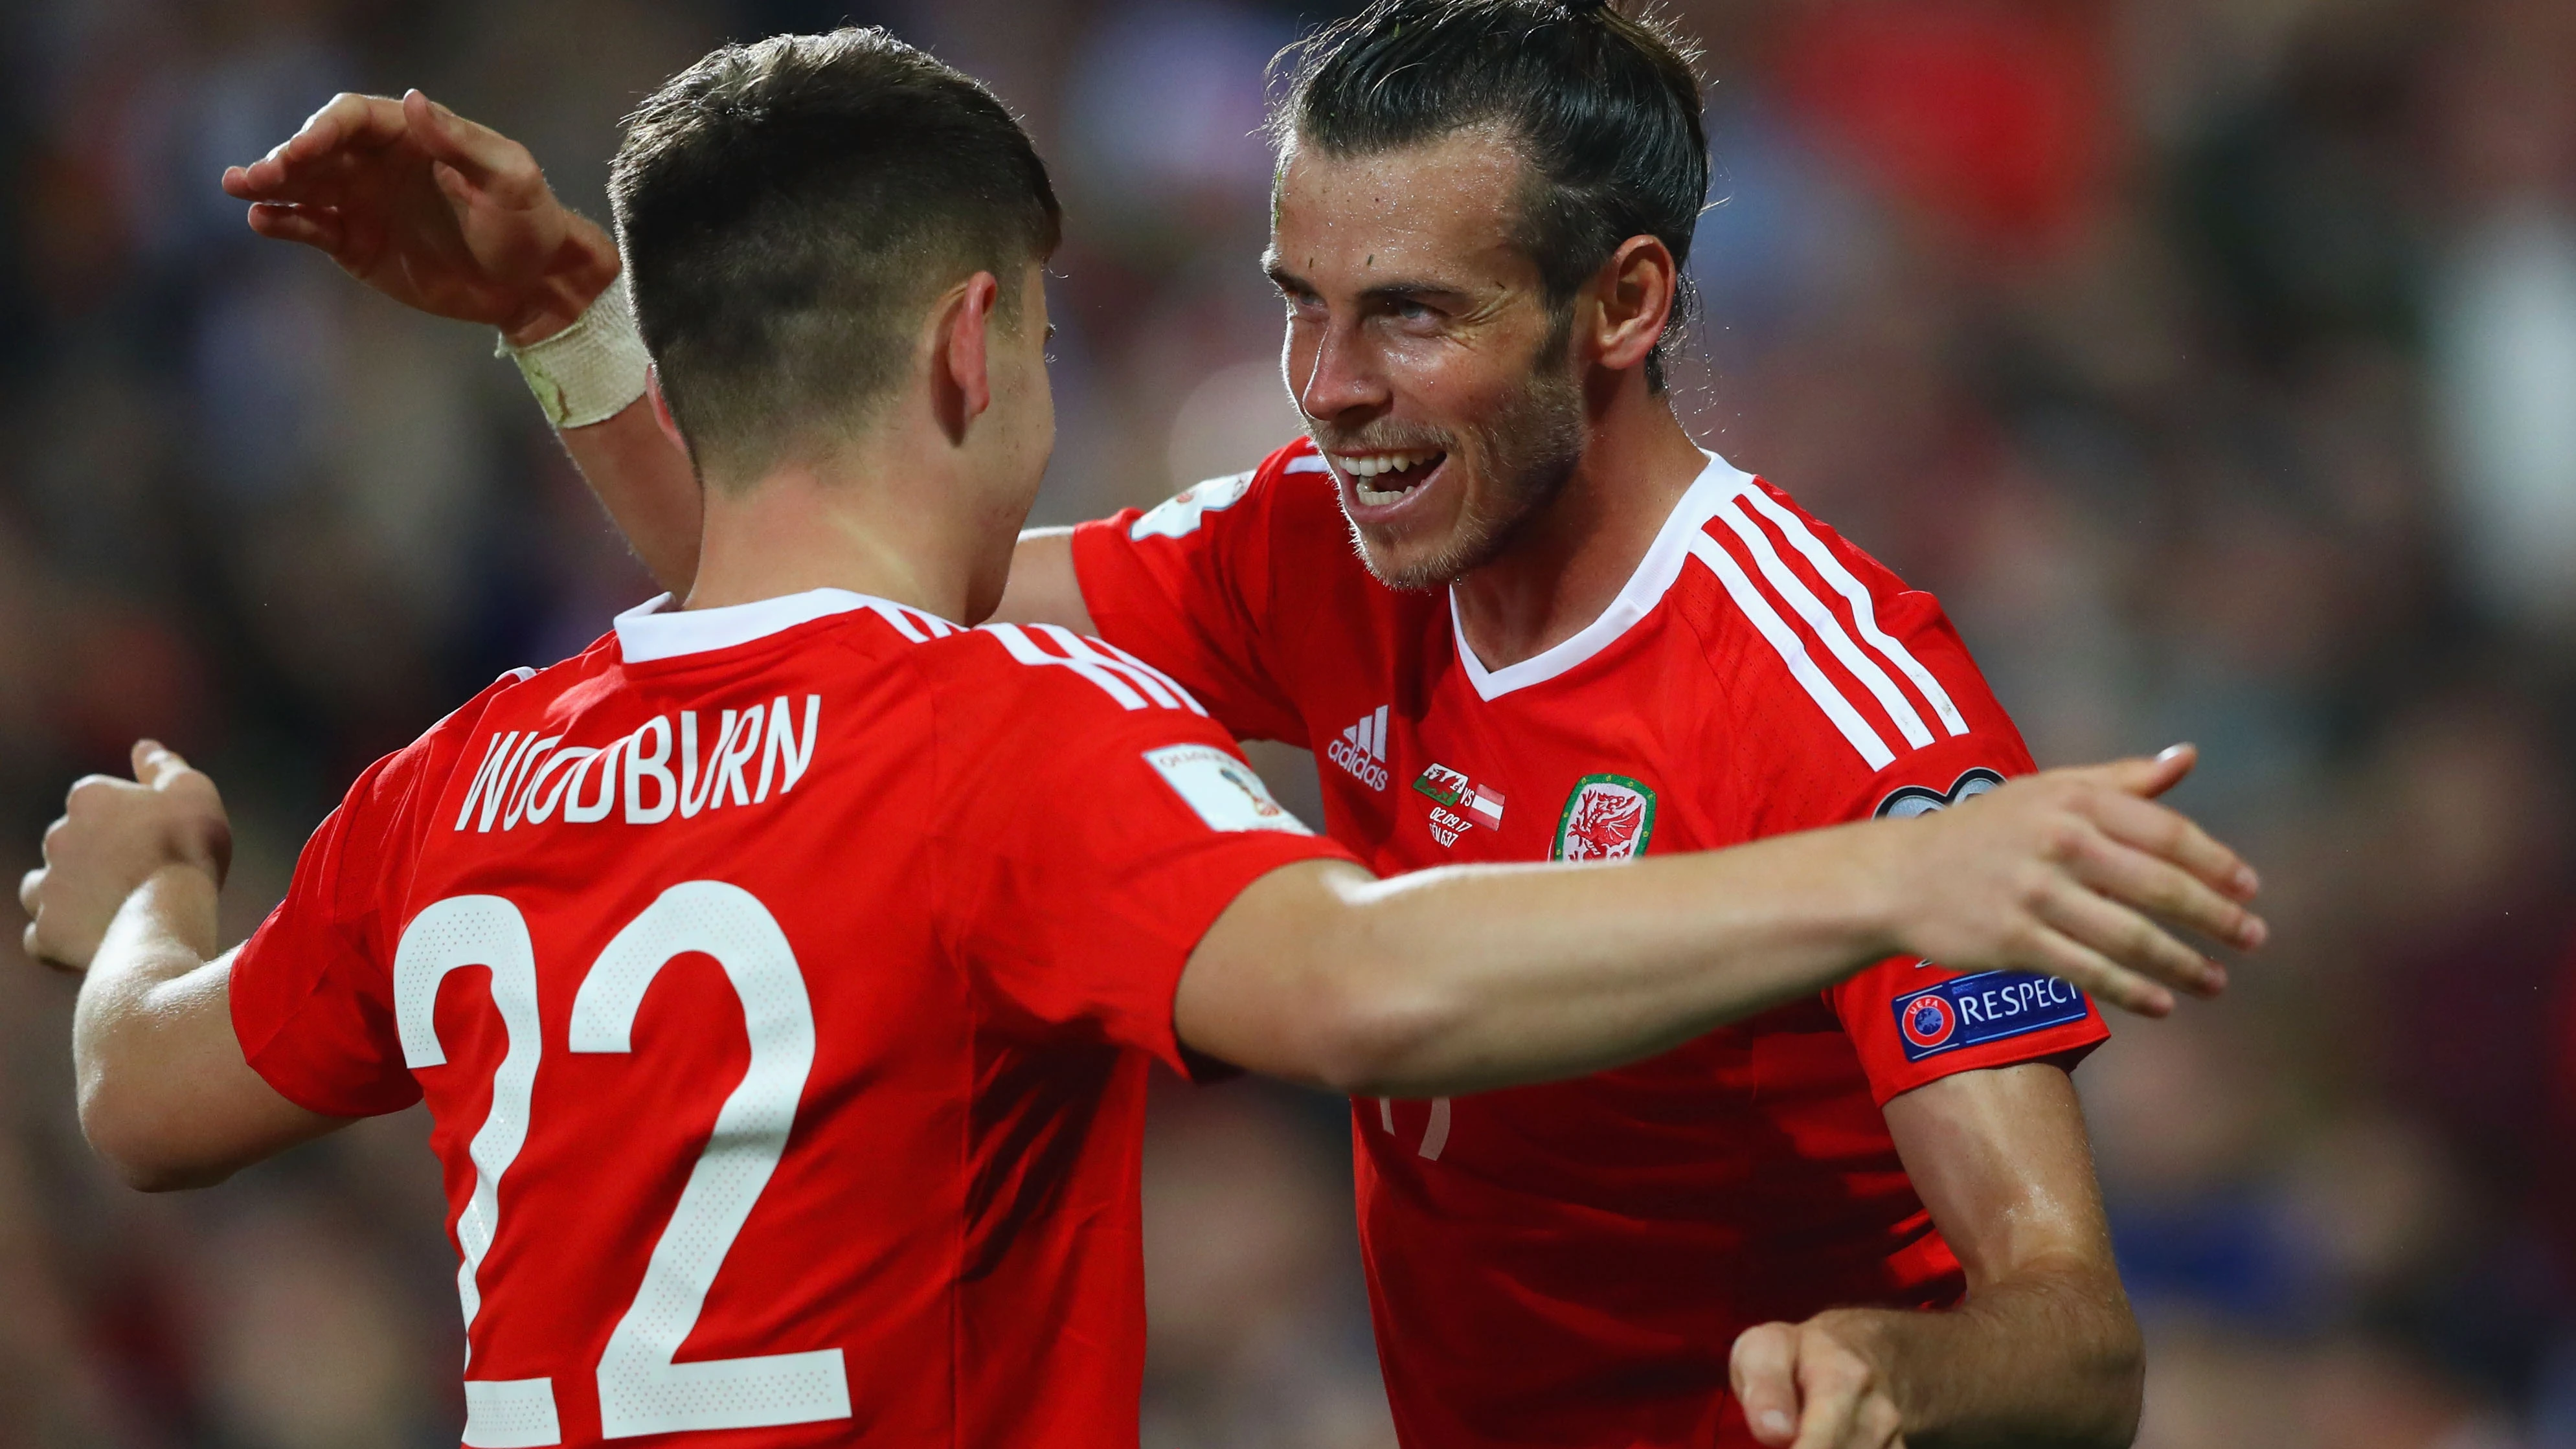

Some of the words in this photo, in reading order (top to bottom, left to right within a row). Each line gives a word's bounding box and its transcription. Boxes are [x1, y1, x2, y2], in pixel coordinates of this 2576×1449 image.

[454, 694, 820, 833] WOODBURN
[1328, 739, 1388, 791] adidas
[1460, 787, 1474, 807] VS
[1429, 807, 1473, 833] 02.09.17
[1440, 829, 1459, 848] 637
[1909, 998, 1939, 1015] UEFA
[394, 879, 852, 1448] 22
